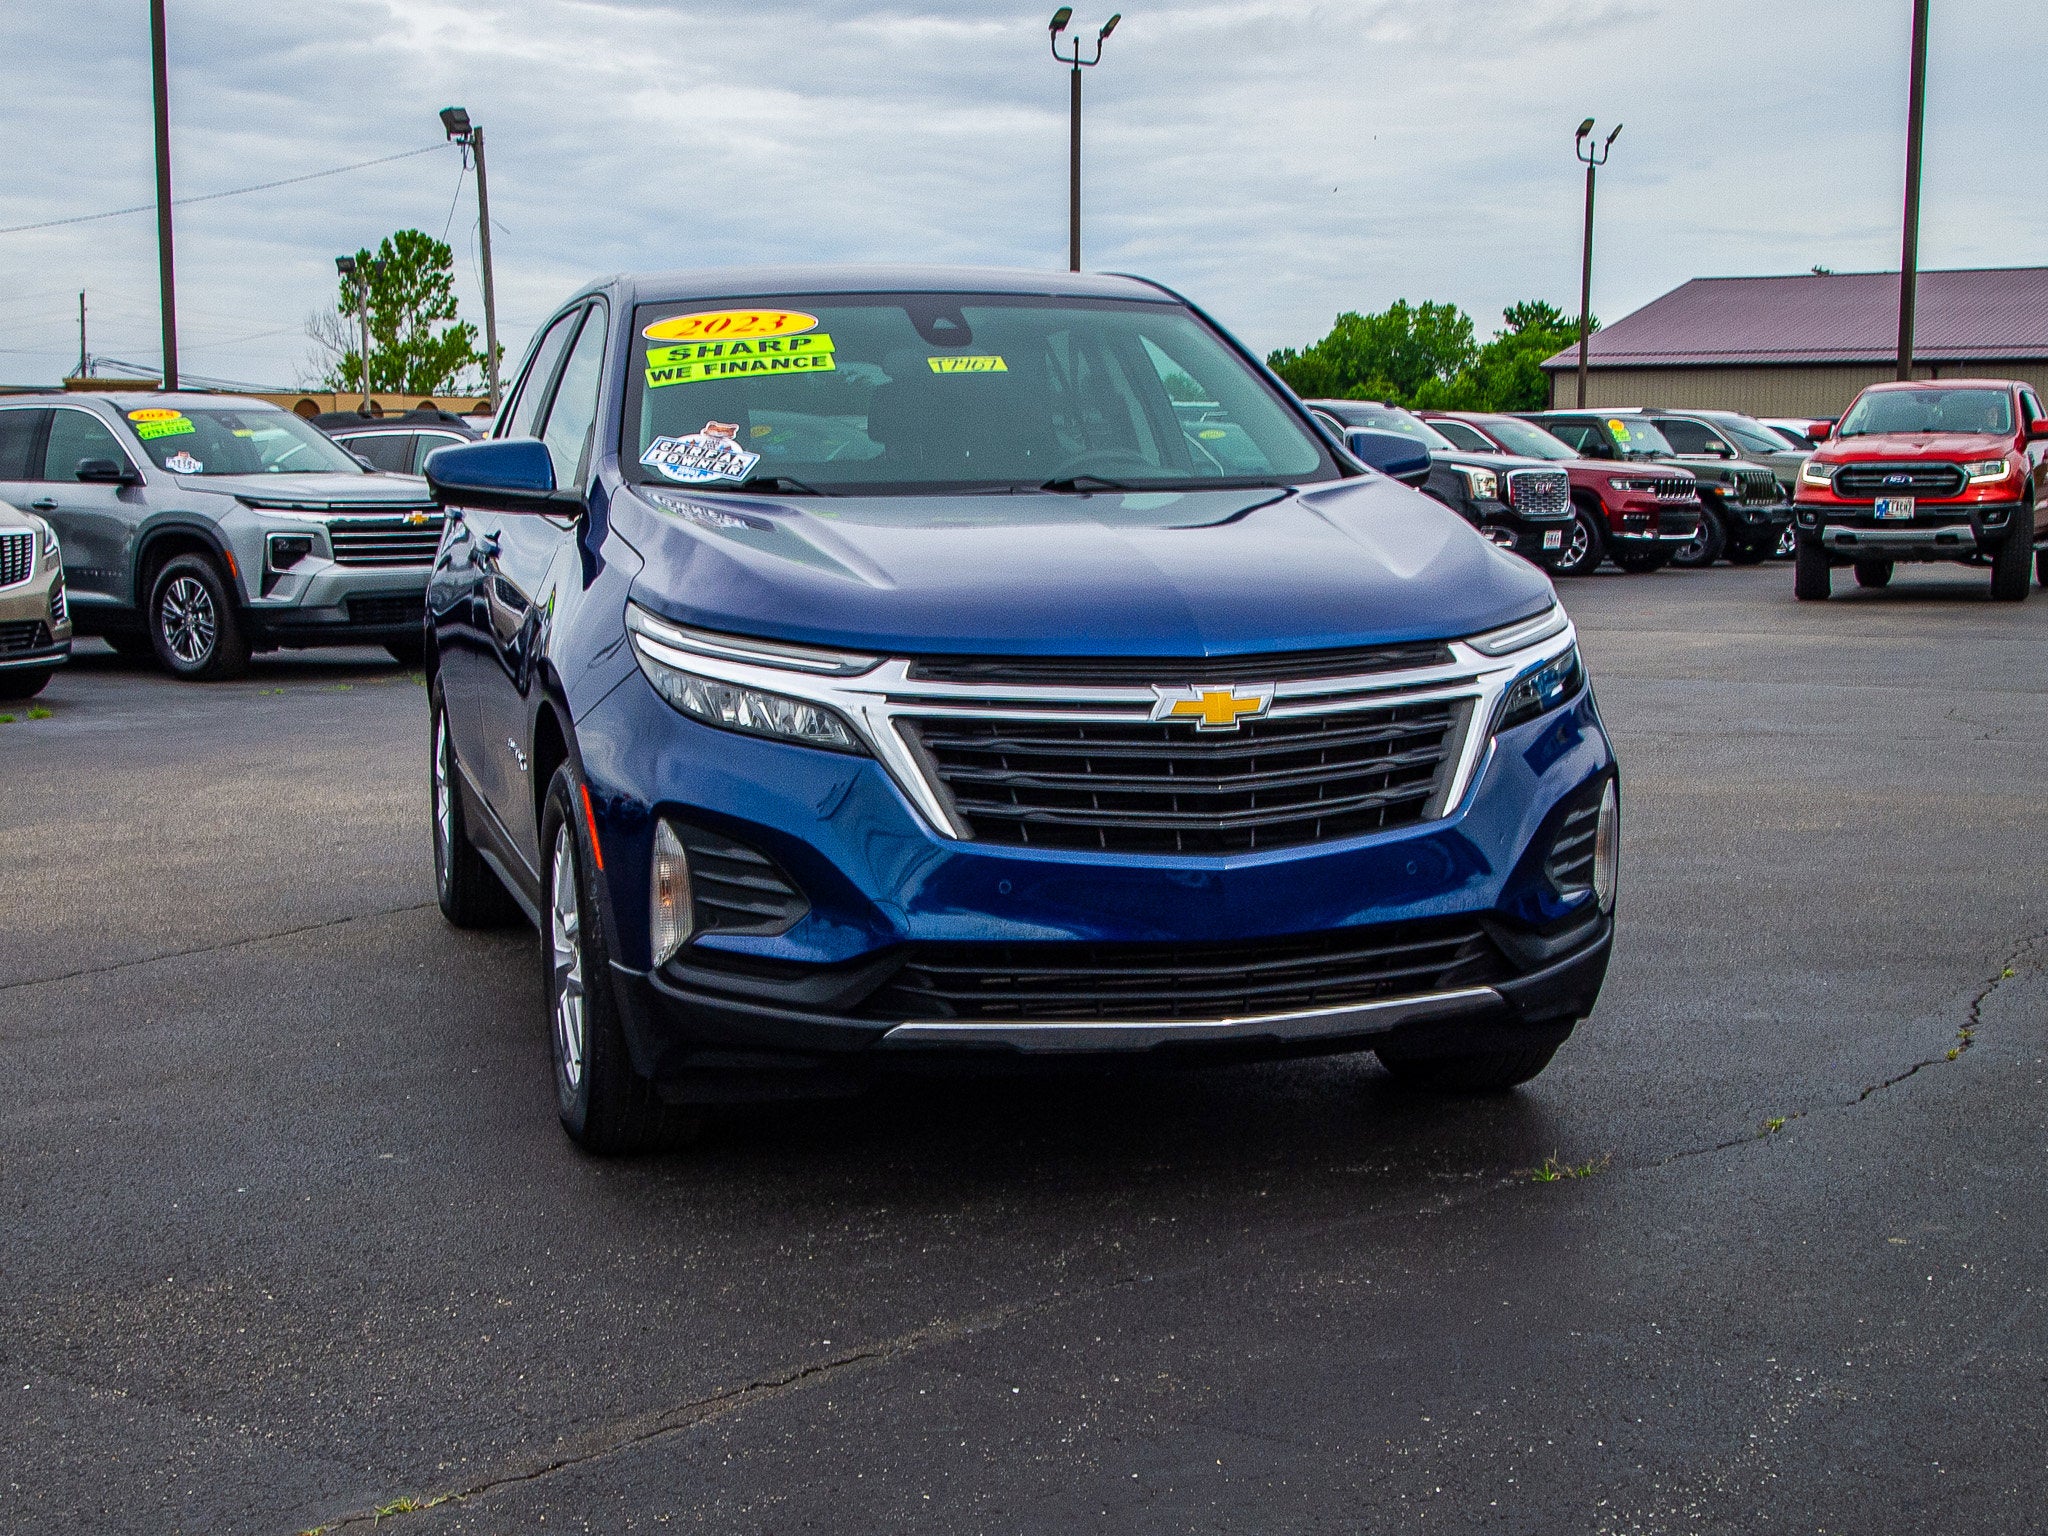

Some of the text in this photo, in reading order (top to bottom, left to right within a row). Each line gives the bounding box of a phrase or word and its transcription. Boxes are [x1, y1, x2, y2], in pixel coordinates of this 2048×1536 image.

[672, 315, 788, 339] 2023
[667, 337, 813, 362] SHARP
[650, 355, 828, 382] WE FINANCE
[666, 452, 743, 476] OWNER
